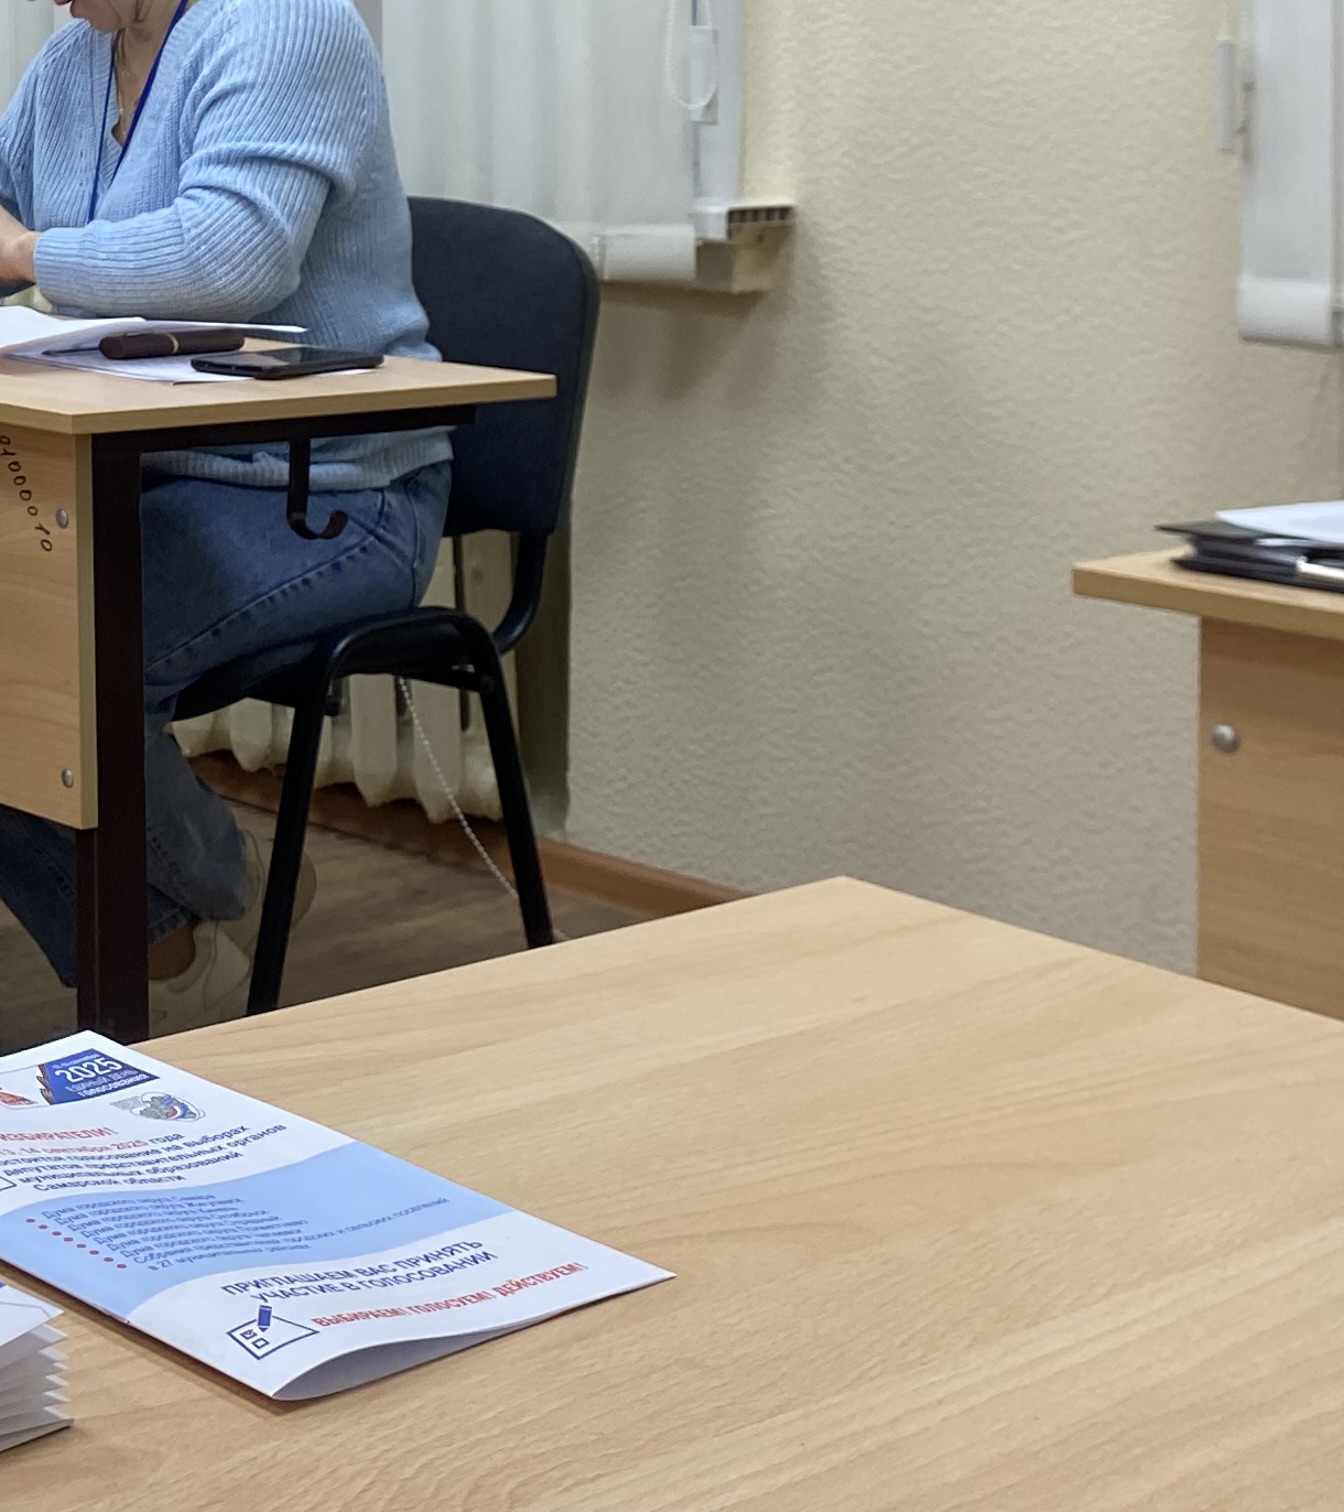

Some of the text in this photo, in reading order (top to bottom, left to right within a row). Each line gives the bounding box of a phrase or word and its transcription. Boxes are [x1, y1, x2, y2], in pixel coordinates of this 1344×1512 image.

[55, 1057, 123, 1083] 2025
[149, 1132, 185, 1146] года
[183, 1125, 250, 1148] выборах
[226, 1124, 287, 1148] органов
[220, 1239, 483, 1297] ПРИГЛАШАЕМ ВАС ПРИНЯТЬ
[249, 1251, 499, 1303] УЧАСТИЕ В ГОЛОСОВАНИИ
[311, 1262, 589, 1327] ВЫБИРАЕМ! ГОЛОСУЕМ! ДЕЙСТВУЕМ!
